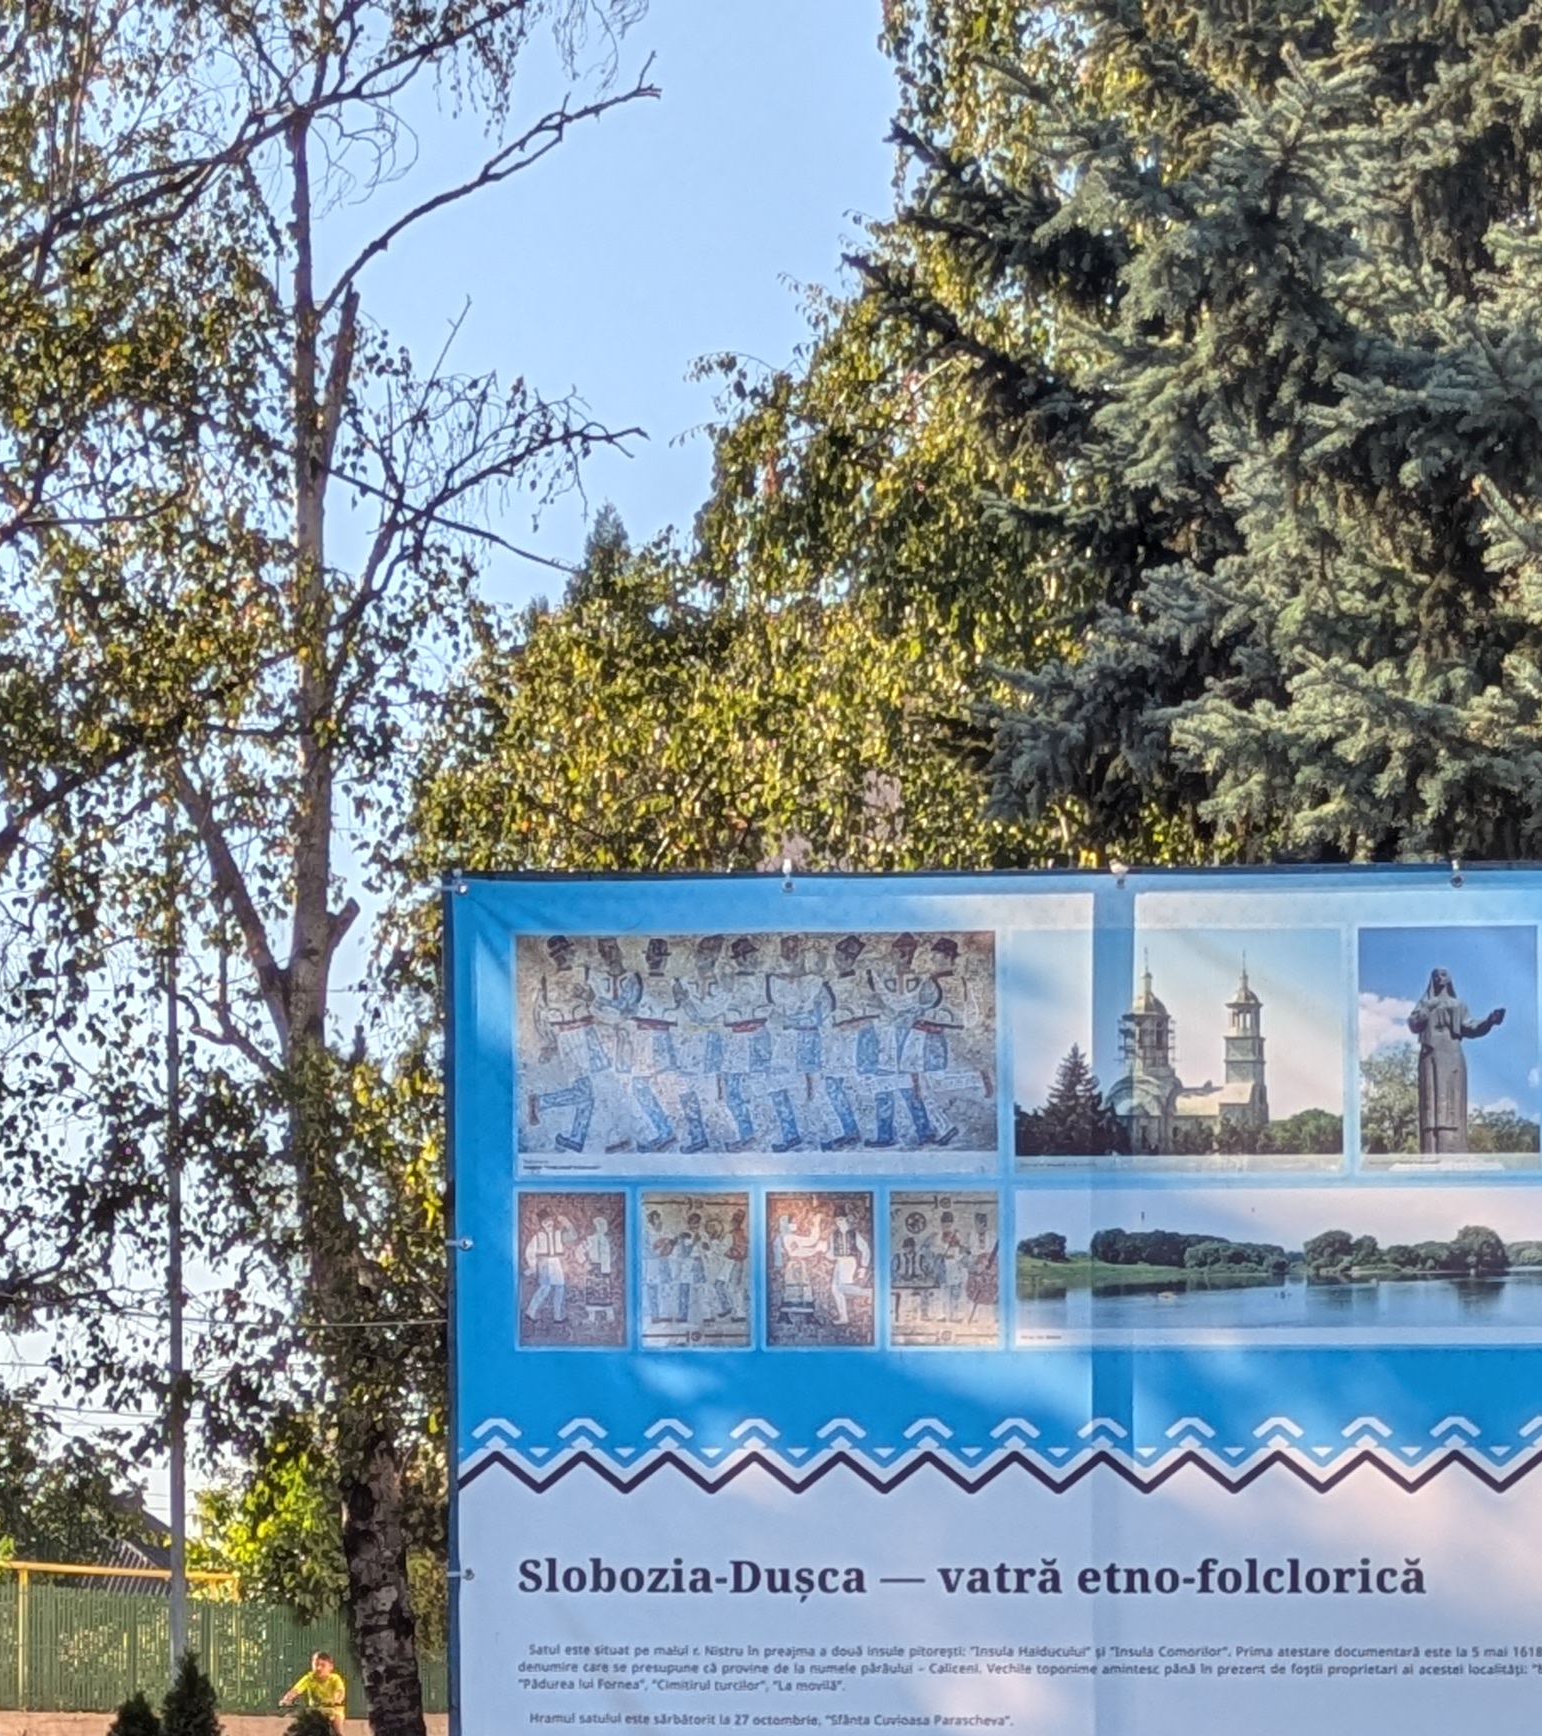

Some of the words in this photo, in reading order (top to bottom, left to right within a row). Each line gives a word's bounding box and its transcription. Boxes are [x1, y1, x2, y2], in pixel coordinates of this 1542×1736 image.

[518, 1557, 867, 1603] Slobozia-Dușca
[936, 1557, 1063, 1595] vatră
[1077, 1557, 1427, 1595] etno-folclorică
[528, 1644, 561, 1656] Satul
[564, 1644, 592, 1656] este
[593, 1644, 630, 1656] situat
[633, 1646, 650, 1658] pe
[653, 1644, 689, 1656] malul
[692, 1647, 701, 1657] r.
[704, 1645, 745, 1657] Nistru
[746, 1645, 760, 1657] în
[763, 1645, 816, 1659] preajma
[818, 1647, 828, 1657] a
[830, 1645, 864, 1657] două
[866, 1645, 906, 1657] insule
[1094, 1646, 1107, 1660] și
[1235, 1646, 1274, 1658] Prima
[1277, 1646, 1331, 1658] atestare
[1333, 1646, 1421, 1658] documentară
[1423, 1646, 1453, 1658] este
[1455, 1646, 1469, 1658] la
[1471, 1646, 1481, 1658] 5
[1483, 1646, 1509, 1658] mai
[517, 1661, 579, 1673] denumire
[582, 1663, 610, 1673] care
[612, 1663, 628, 1673] se
[631, 1663, 700, 1675] presupune
[702, 1662, 718, 1674] că
[721, 1662, 770, 1676] provine
[772, 1662, 790, 1674] de
[793, 1662, 806, 1674] la
[809, 1662, 857, 1674] numele
[986, 1663, 1033, 1675] Vechile
[1035, 1663, 1099, 1677] toponime
[1101, 1663, 1161, 1675] amintesc
[1199, 1663, 1214, 1675] în
[1216, 1663, 1266, 1677] prezent
[1269, 1663, 1287, 1675] de
[1290, 1663, 1324, 1677] foștii
[1327, 1663, 1398, 1677] proprietari
[1401, 1663, 1414, 1675] ai
[1418, 1663, 1465, 1675] acestei
[578, 1678, 595, 1690] lui
[529, 1712, 576, 1724] Hramul
[578, 1712, 623, 1724] satului
[624, 1713, 651, 1725] este
[718, 1713, 732, 1725] la
[733, 1713, 750, 1725] 27
[873, 1714, 931, 1726] Cuvioasa
